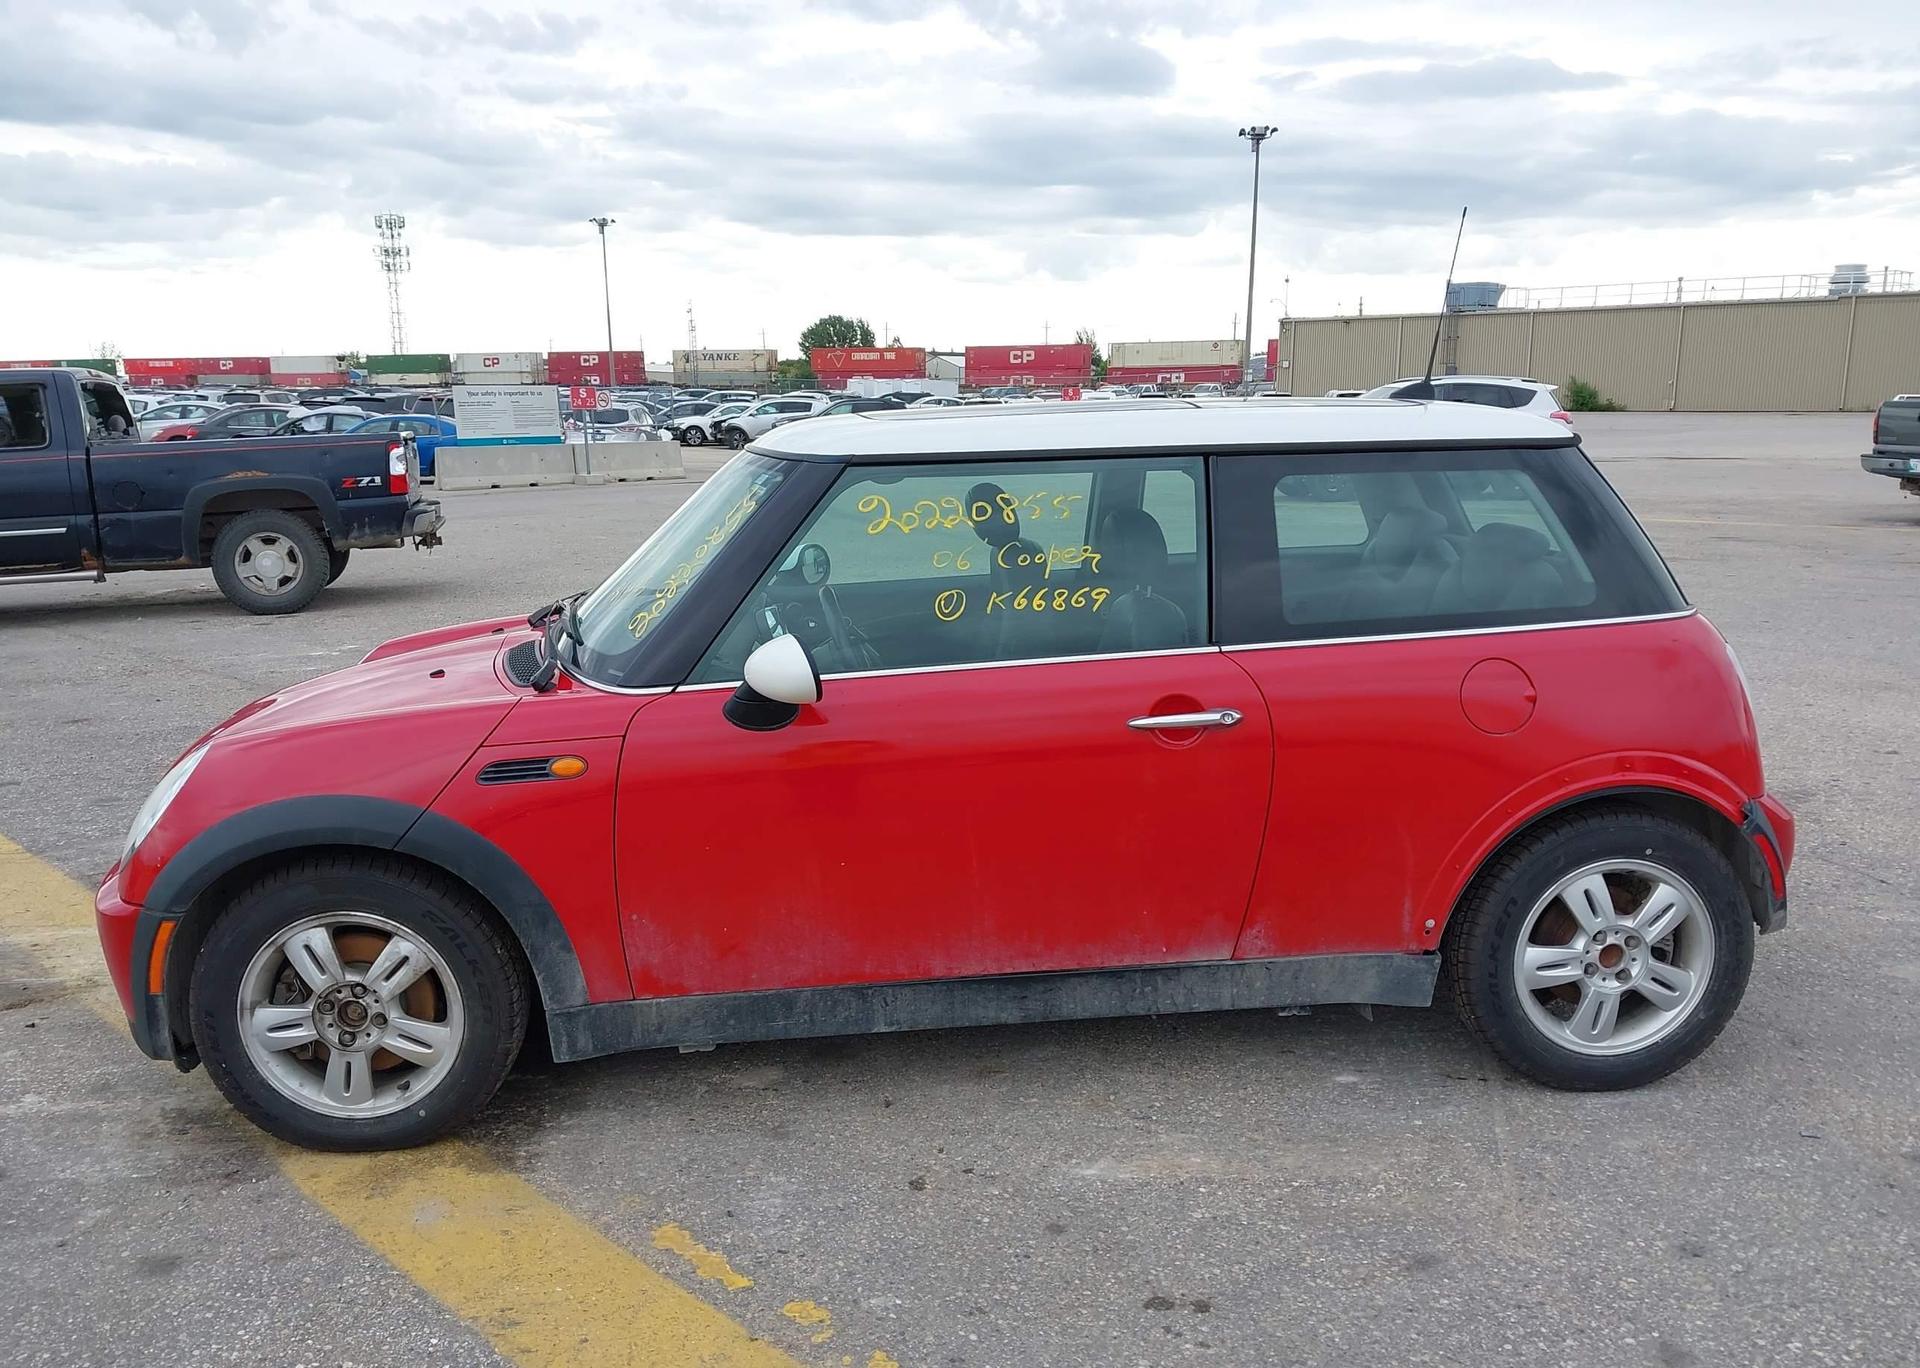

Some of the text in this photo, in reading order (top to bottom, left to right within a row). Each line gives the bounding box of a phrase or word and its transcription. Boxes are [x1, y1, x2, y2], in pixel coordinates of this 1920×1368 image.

[580, 355, 599, 366] CP
[702, 352, 740, 361] YANKE
[851, 351, 897, 361] CANADIAN TIRE
[1009, 350, 1035, 364] CP
[220, 360, 233, 369] CP
[483, 357, 500, 368] CP
[466, 390, 479, 399] Your
[480, 389, 497, 397] safety
[503, 390, 529, 398] important
[579, 388, 587, 398] S
[342, 476, 382, 488] Z71
[857, 492, 1083, 535] 20220855
[998, 541, 1103, 579] Cooper
[986, 585, 1111, 614] K66869
